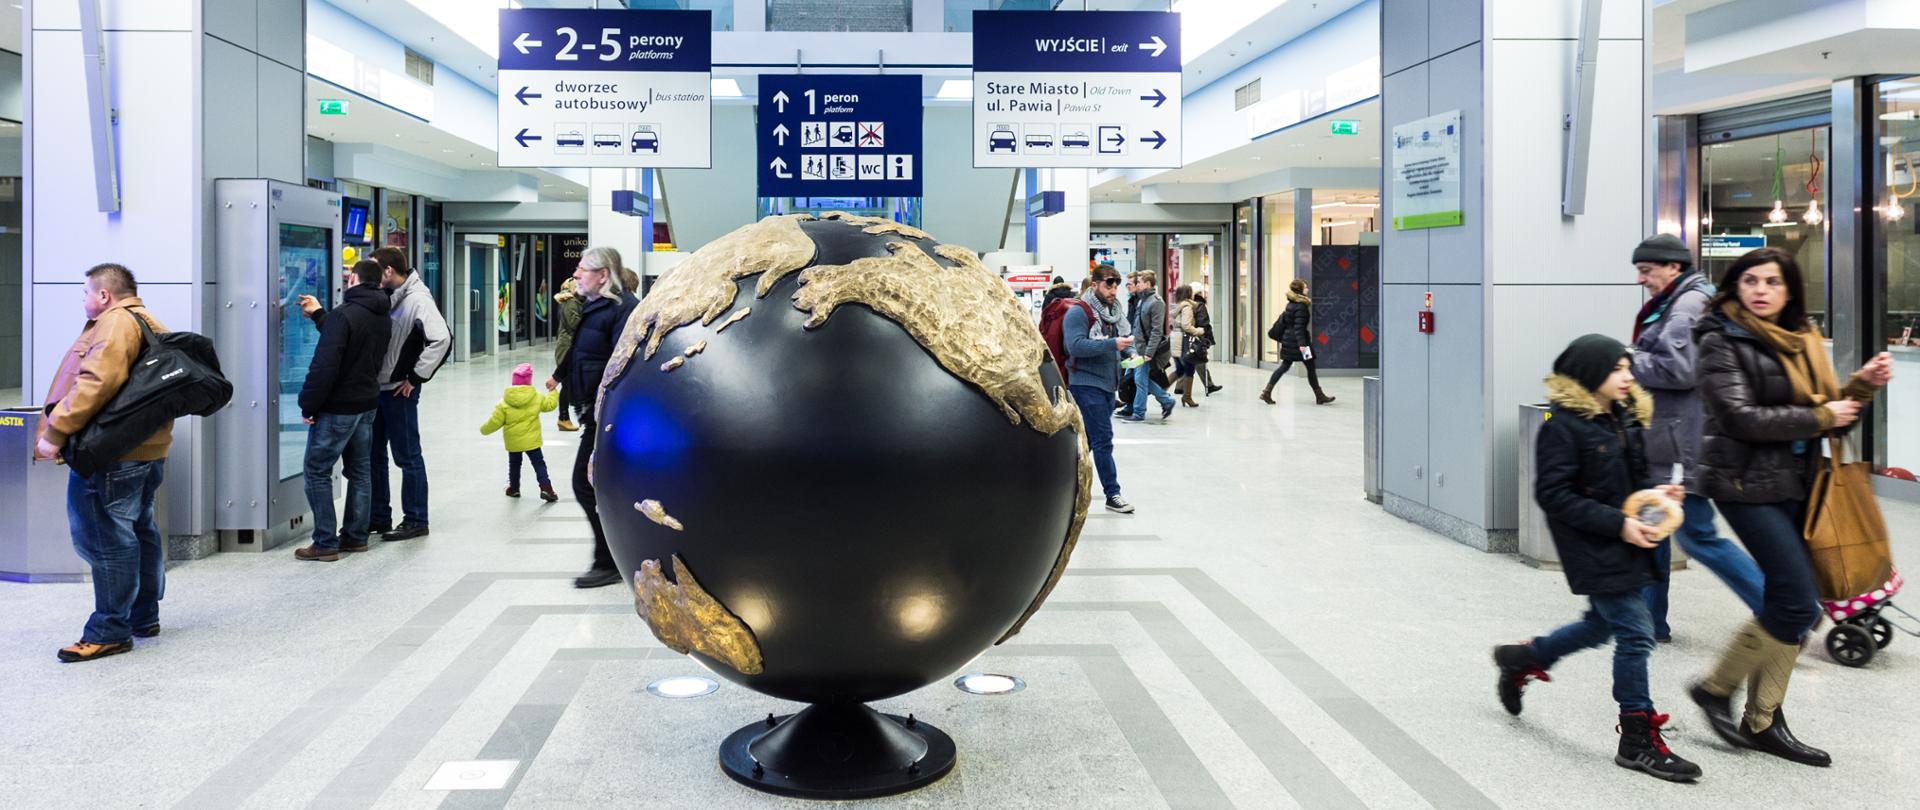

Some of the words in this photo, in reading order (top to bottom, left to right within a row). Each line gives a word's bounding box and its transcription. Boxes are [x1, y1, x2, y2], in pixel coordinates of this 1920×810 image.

[555, 26, 622, 61] 2-5
[629, 35, 684, 49] perony
[1035, 36, 1099, 52] WYJŚCIE
[1111, 43, 1128, 53] exit
[628, 49, 674, 61] platforms
[555, 80, 618, 93] dworzec
[987, 82, 1025, 95] Stare
[1029, 82, 1079, 95] Miasto
[1090, 86, 1106, 96] Old
[1108, 87, 1132, 96] Town
[655, 92, 672, 102] bus
[674, 91, 705, 102] station
[804, 89, 816, 115] 1
[824, 93, 859, 105] peron
[555, 97, 648, 113] autobusowy
[824, 106, 854, 115] platform
[987, 99, 1005, 112] ul.
[1009, 99, 1052, 112] Pawia
[1063, 104, 1091, 112] Pawia
[1092, 104, 1102, 112] St
[861, 164, 881, 175] WC
